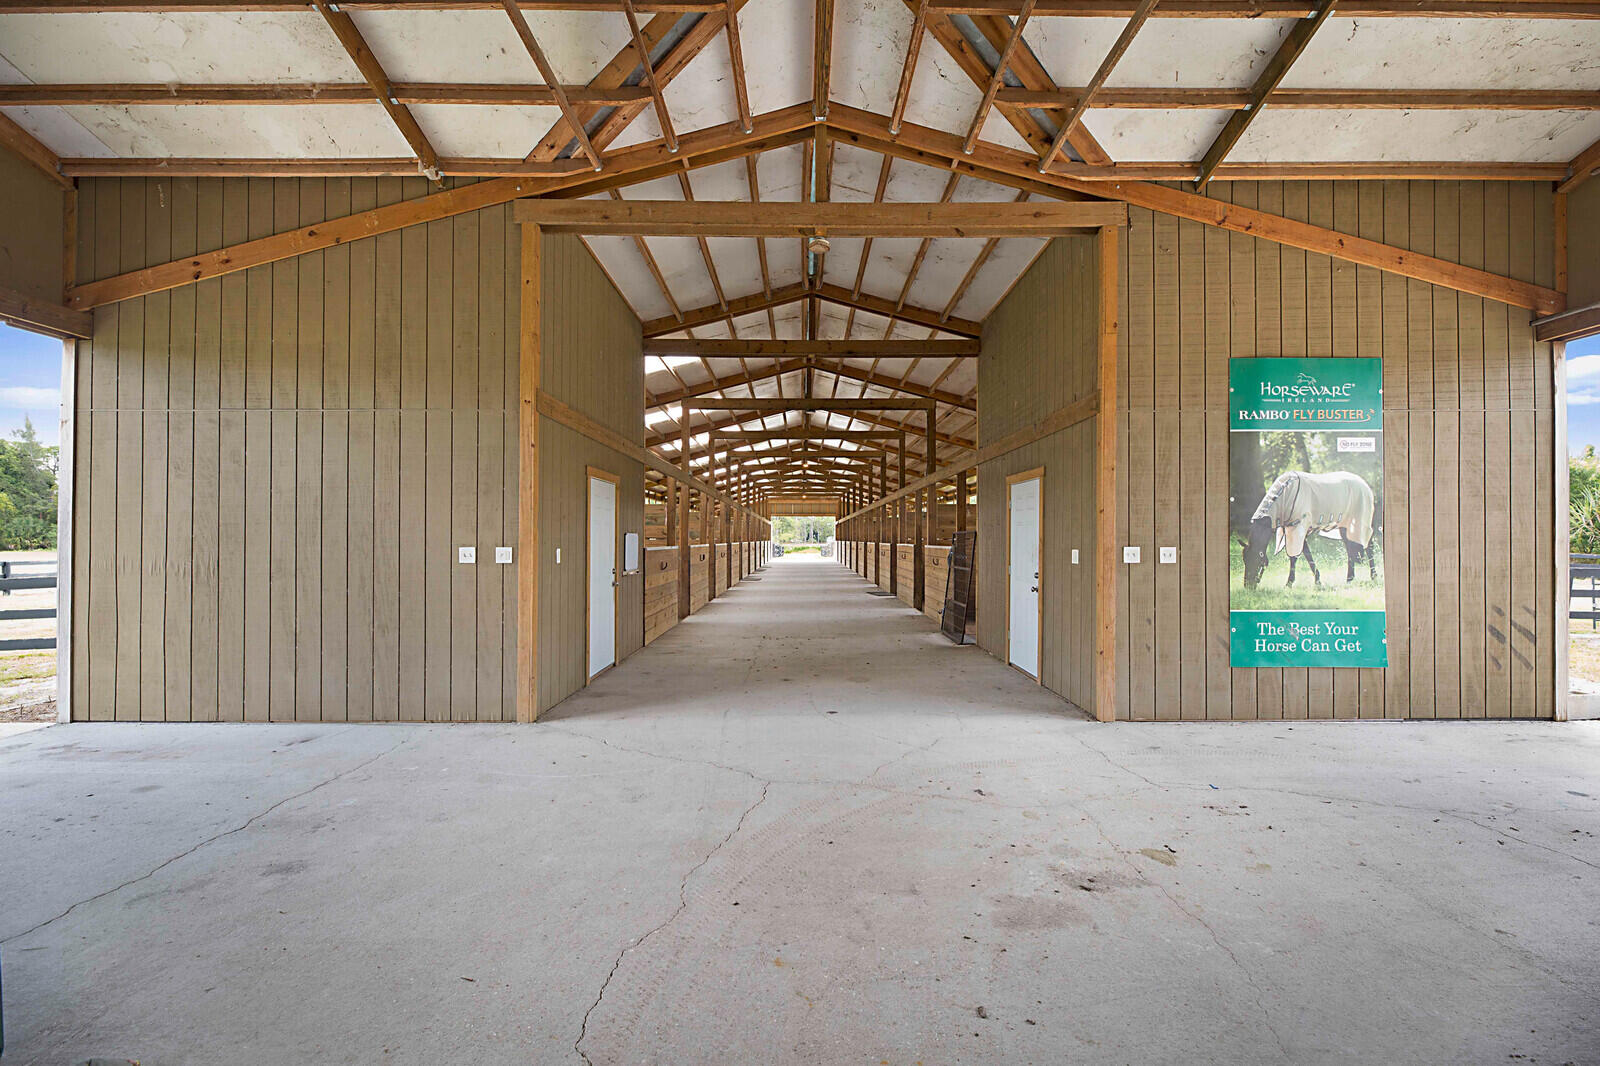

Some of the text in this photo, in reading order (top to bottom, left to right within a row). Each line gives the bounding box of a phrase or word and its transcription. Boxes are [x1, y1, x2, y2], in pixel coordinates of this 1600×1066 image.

[1239, 409, 1364, 420] RAMBO FLY BUSTER
[1256, 622, 1359, 635] The Best Your
[1254, 639, 1362, 652] Horse Can Get
